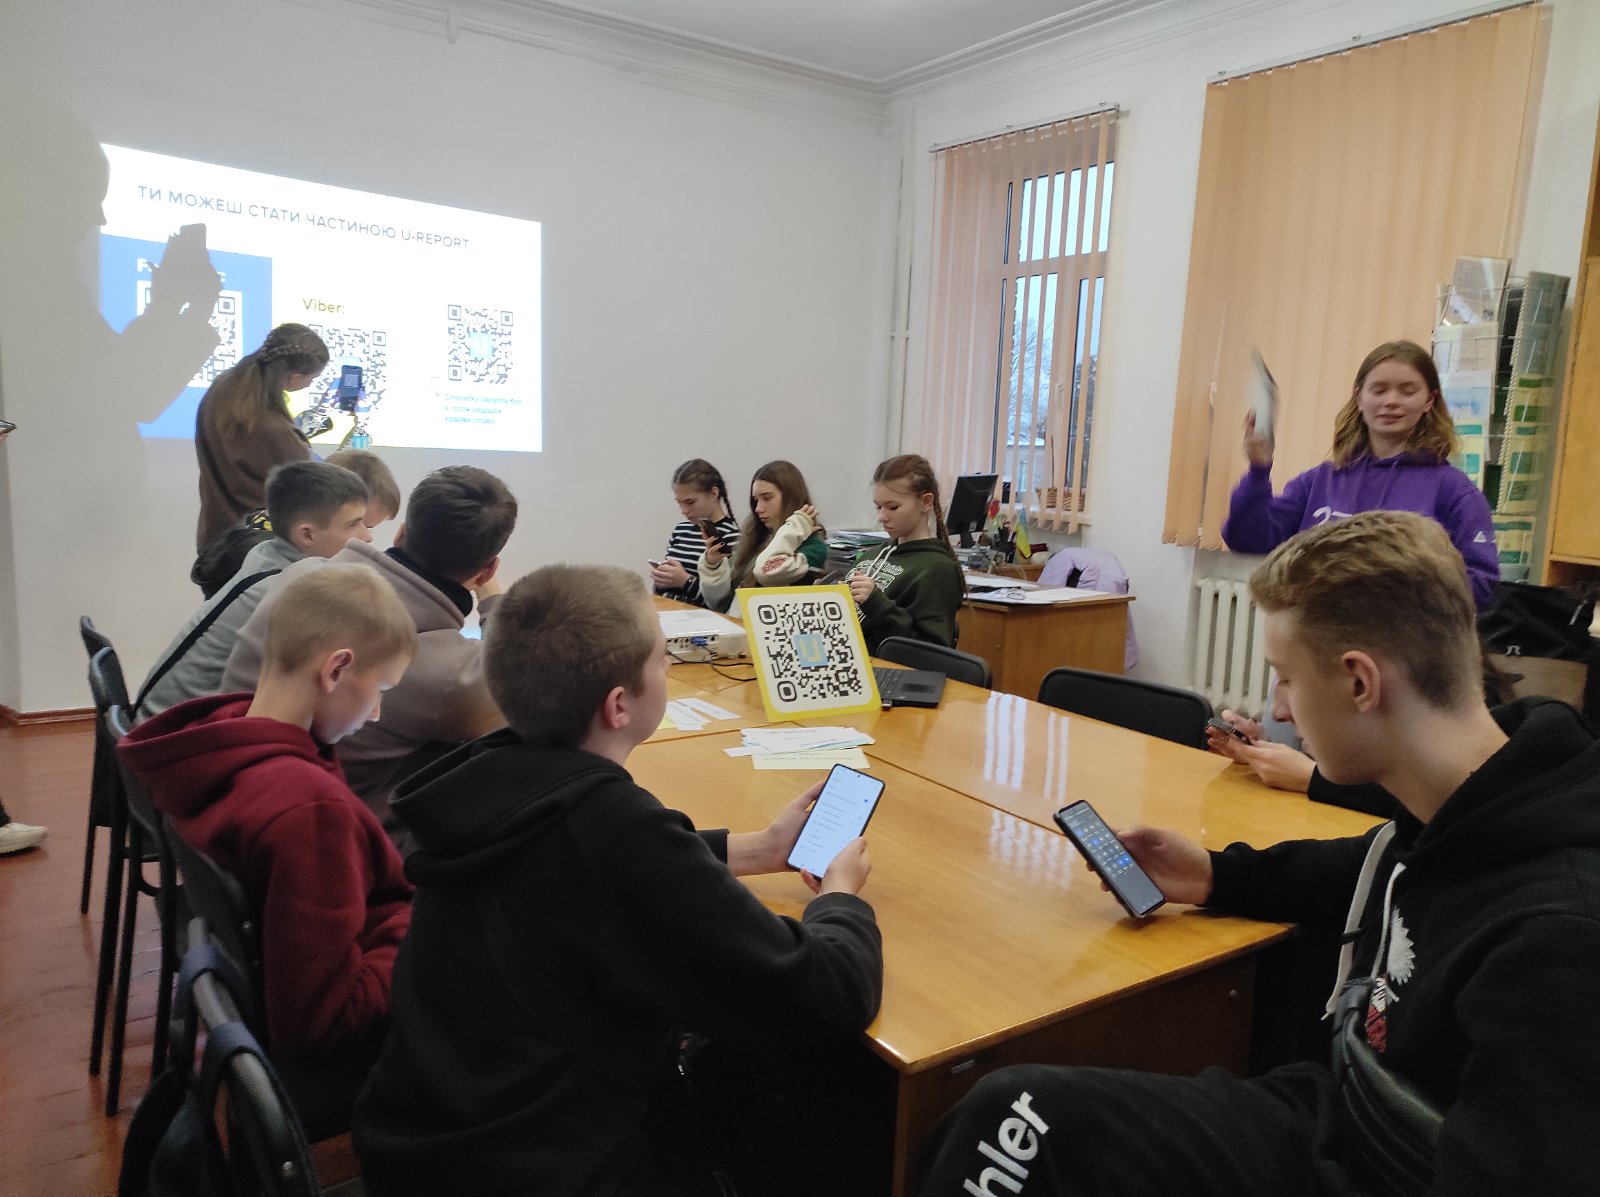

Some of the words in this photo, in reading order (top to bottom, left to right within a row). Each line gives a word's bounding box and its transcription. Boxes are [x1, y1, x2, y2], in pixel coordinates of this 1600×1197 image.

[138, 185, 162, 201] ТИ
[168, 190, 242, 215] МОЖЕШ
[248, 204, 301, 224] СТАТИ
[306, 213, 396, 239] ЧАСТИНОЮ
[401, 228, 470, 249] U-REPORT
[302, 297, 345, 314] Viber:
